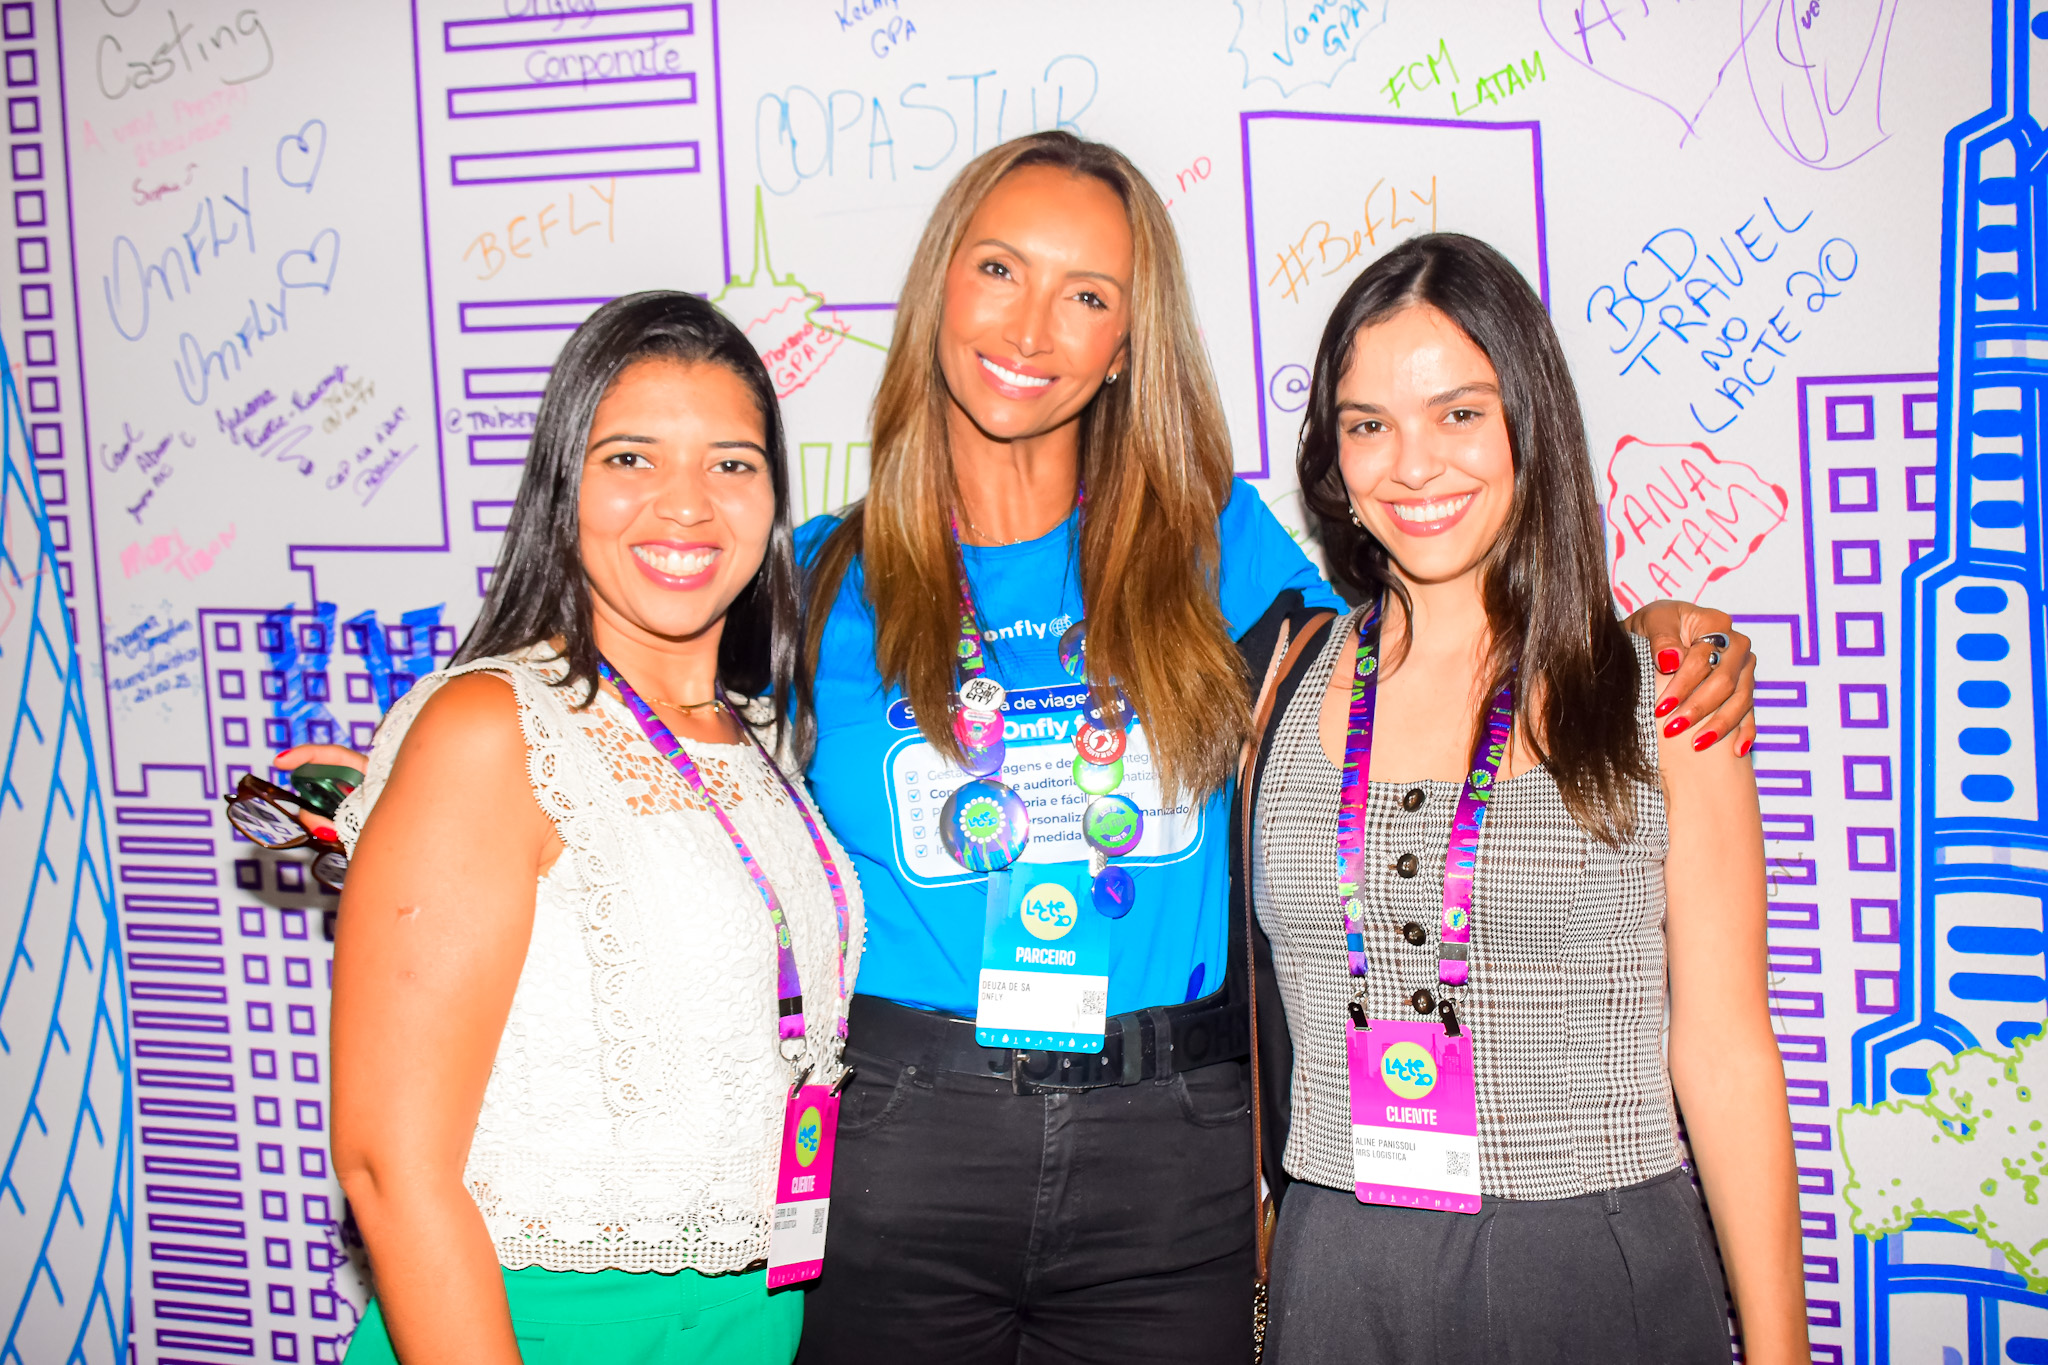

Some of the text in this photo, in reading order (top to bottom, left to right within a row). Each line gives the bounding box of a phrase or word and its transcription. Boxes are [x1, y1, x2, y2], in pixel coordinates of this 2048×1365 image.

[870, 15, 918, 60] GPA
[524, 35, 682, 92] Corporate
[1379, 38, 1460, 110] FCM
[1450, 50, 1547, 117] LATAM
[461, 177, 617, 282] BEFLY
[1587, 228, 1697, 354] BCD
[1619, 196, 1814, 376] TRAVEL
[1689, 237, 1858, 433] LACTE 20
[1700, 317, 1749, 371] NO
[775, 342, 818, 389] GPA
[1623, 458, 1723, 545] ANA
[1013, 696, 1037, 710] de
[1002, 717, 1069, 741] Onfly
[1033, 831, 1082, 843] medida
[1015, 946, 1077, 967] PARCEIRO
[982, 980, 1031, 992] DEUZA DE SA
[1385, 1105, 1438, 1126] CLIENTE
[1355, 1137, 1416, 1151] ALINE PANISSOLI
[1355, 1148, 1407, 1161] MRS LOGISTICA
